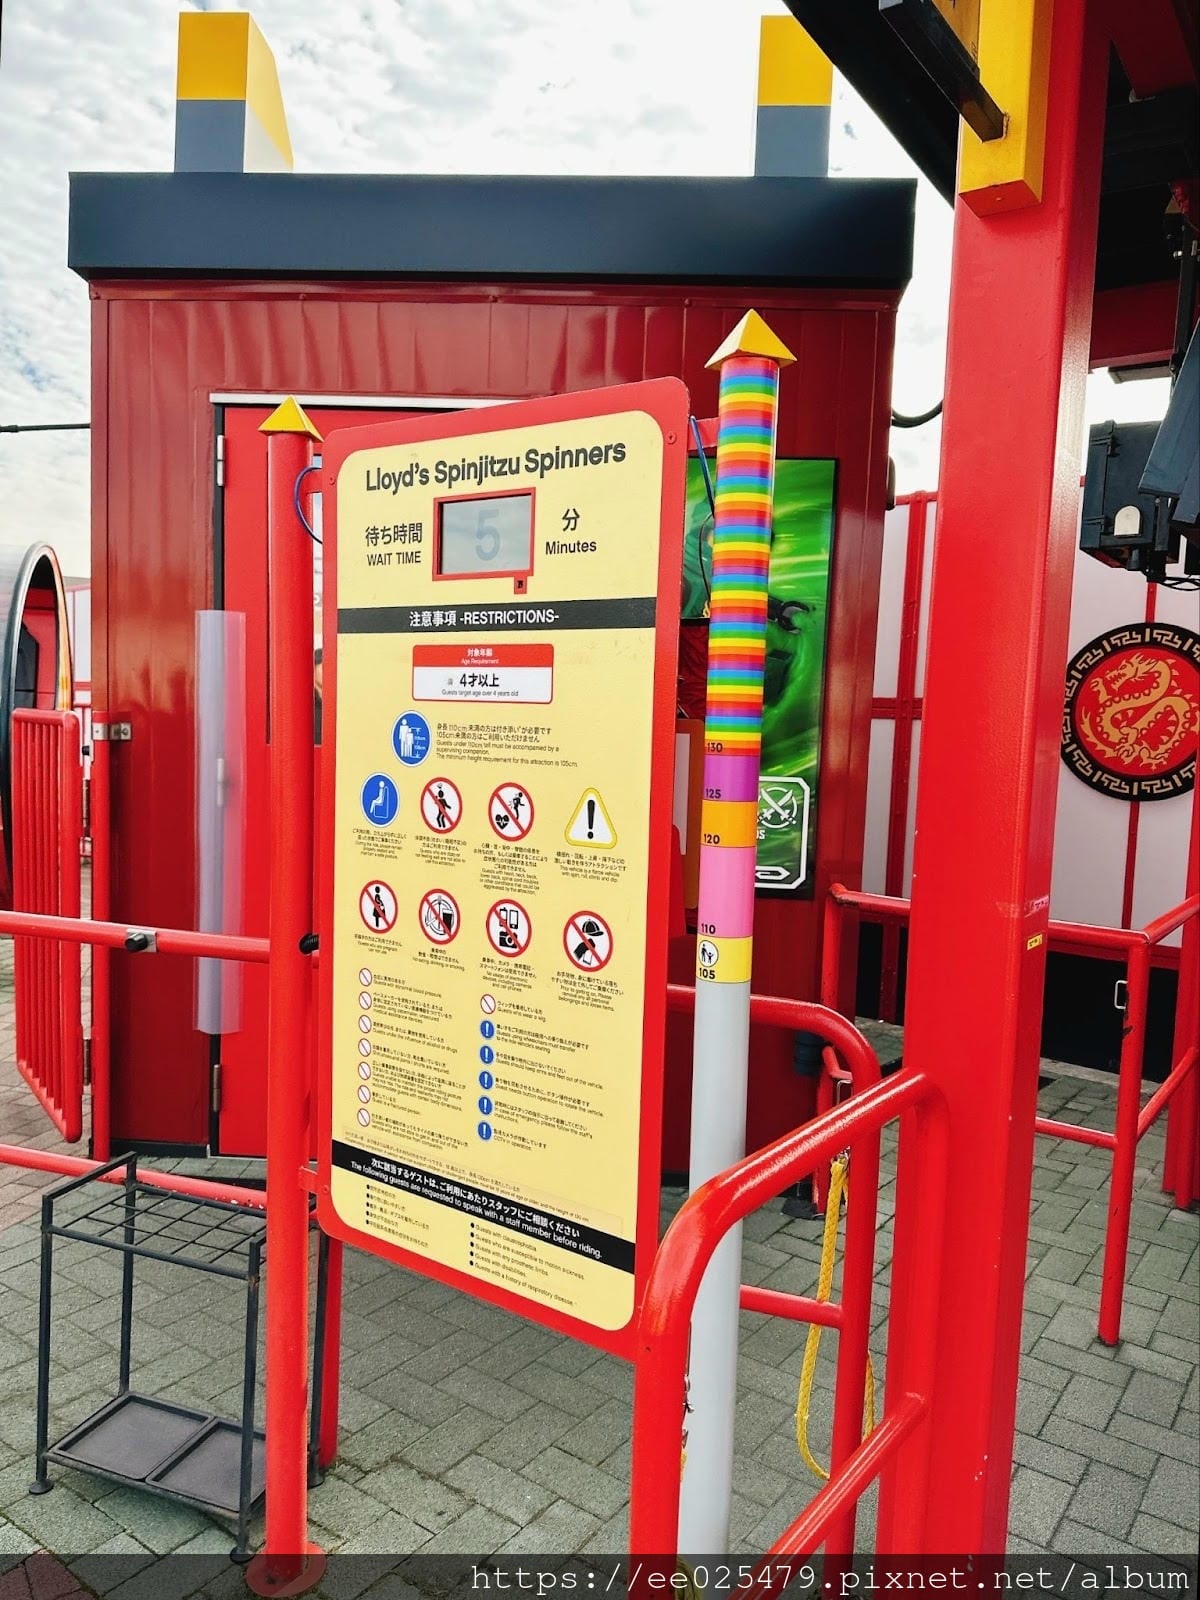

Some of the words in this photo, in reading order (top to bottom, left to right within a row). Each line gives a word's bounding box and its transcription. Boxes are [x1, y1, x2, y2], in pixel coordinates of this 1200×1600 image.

[366, 462, 429, 495] Lloyd's
[434, 455, 520, 489] Spinjitzu
[524, 442, 626, 479] Spinners
[562, 508, 580, 532] 分
[365, 522, 422, 547] 待ち時間
[475, 508, 500, 561] 5
[545, 540, 597, 555] Minutes
[366, 553, 392, 566] WAIT
[395, 551, 421, 565] TIME
[409, 610, 456, 627] 注意事項
[460, 609, 559, 625] -RESTRICTIONS-
[459, 673, 500, 688] 4才以上
[707, 743, 723, 753] 130
[705, 788, 721, 799] 125
[703, 834, 720, 844] 120
[701, 923, 716, 935] 110
[699, 968, 715, 980] 105
[371, 1157, 580, 1237] 次に該当するゲストは、ご利用にあたりスタッフにご相談ください
[351, 1161, 361, 1170] The
[362, 1166, 388, 1181] following
[389, 1176, 409, 1188] guests
[410, 1183, 420, 1191] are
[422, 1188, 453, 1203] requested
[454, 1198, 461, 1206] to
[462, 1201, 483, 1216] speak
[484, 1209, 497, 1218] with
[505, 1216, 520, 1227] staff
[521, 1223, 550, 1238] member
[553, 1233, 576, 1247] before
[579, 1243, 601, 1258] riding.
